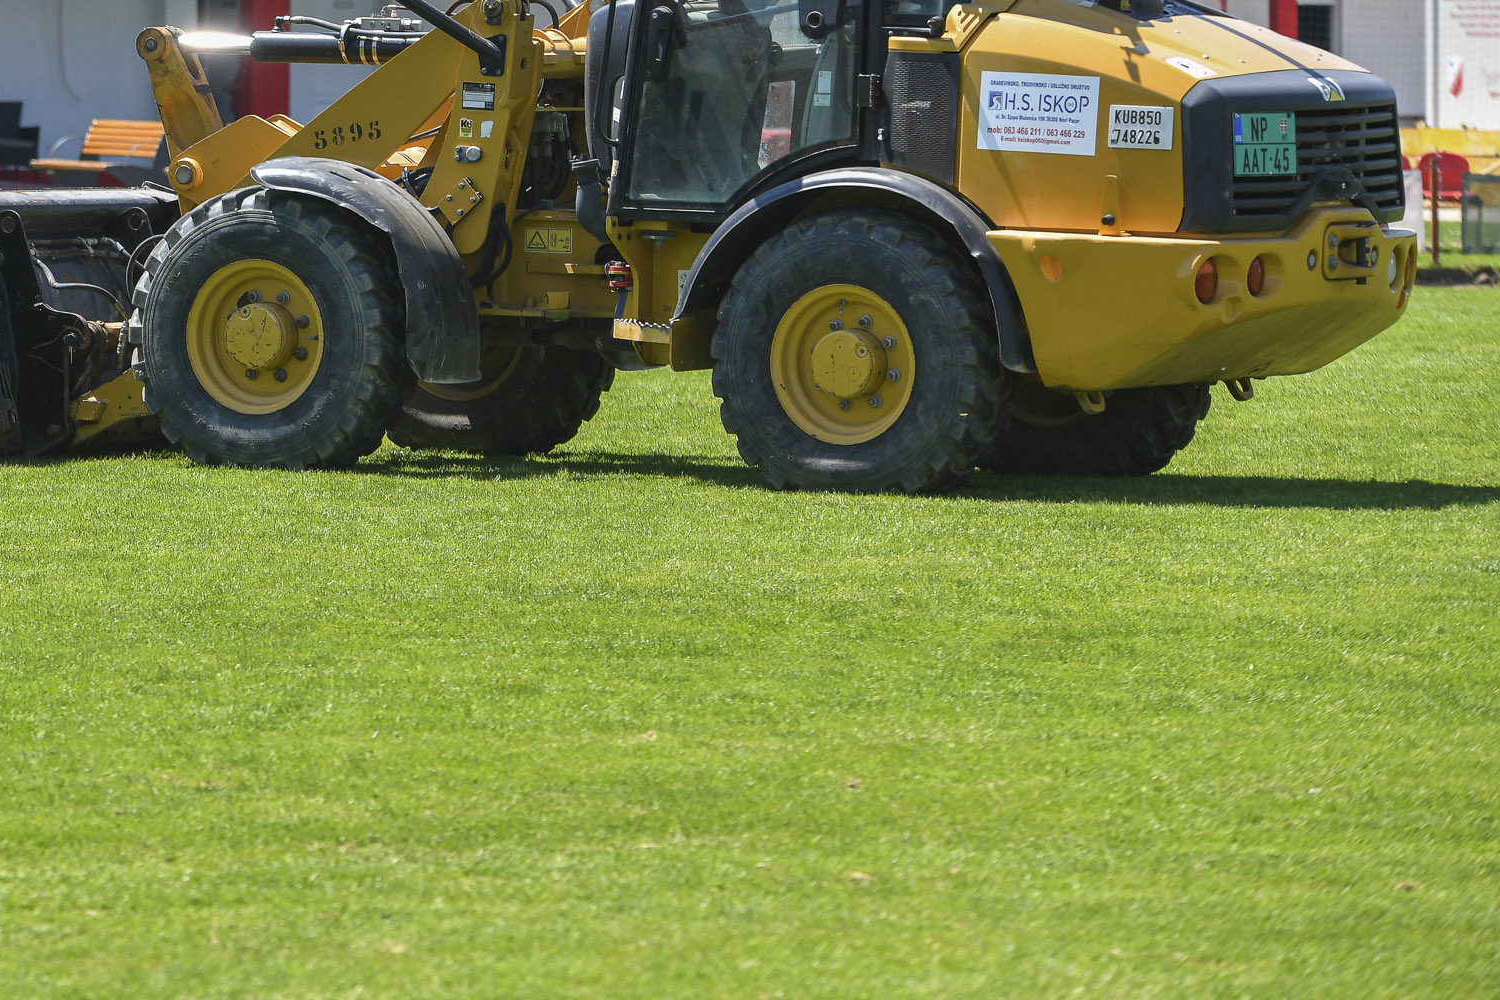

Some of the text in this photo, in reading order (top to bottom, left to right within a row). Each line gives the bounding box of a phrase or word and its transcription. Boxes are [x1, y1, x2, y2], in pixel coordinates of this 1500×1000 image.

[1004, 92, 1090, 113] H.S. ISKOP
[1114, 109, 1161, 126] KUB850
[314, 120, 381, 150] 5895
[987, 126, 1002, 134] mob:
[1003, 126, 1015, 134] 063
[1016, 127, 1028, 135] 466
[1030, 128, 1041, 136] 211
[1046, 129, 1058, 137] 063
[1059, 129, 1071, 137] 466
[1073, 130, 1085, 138] 229
[1112, 129, 1160, 145] 748226
[1250, 117, 1267, 141] NP
